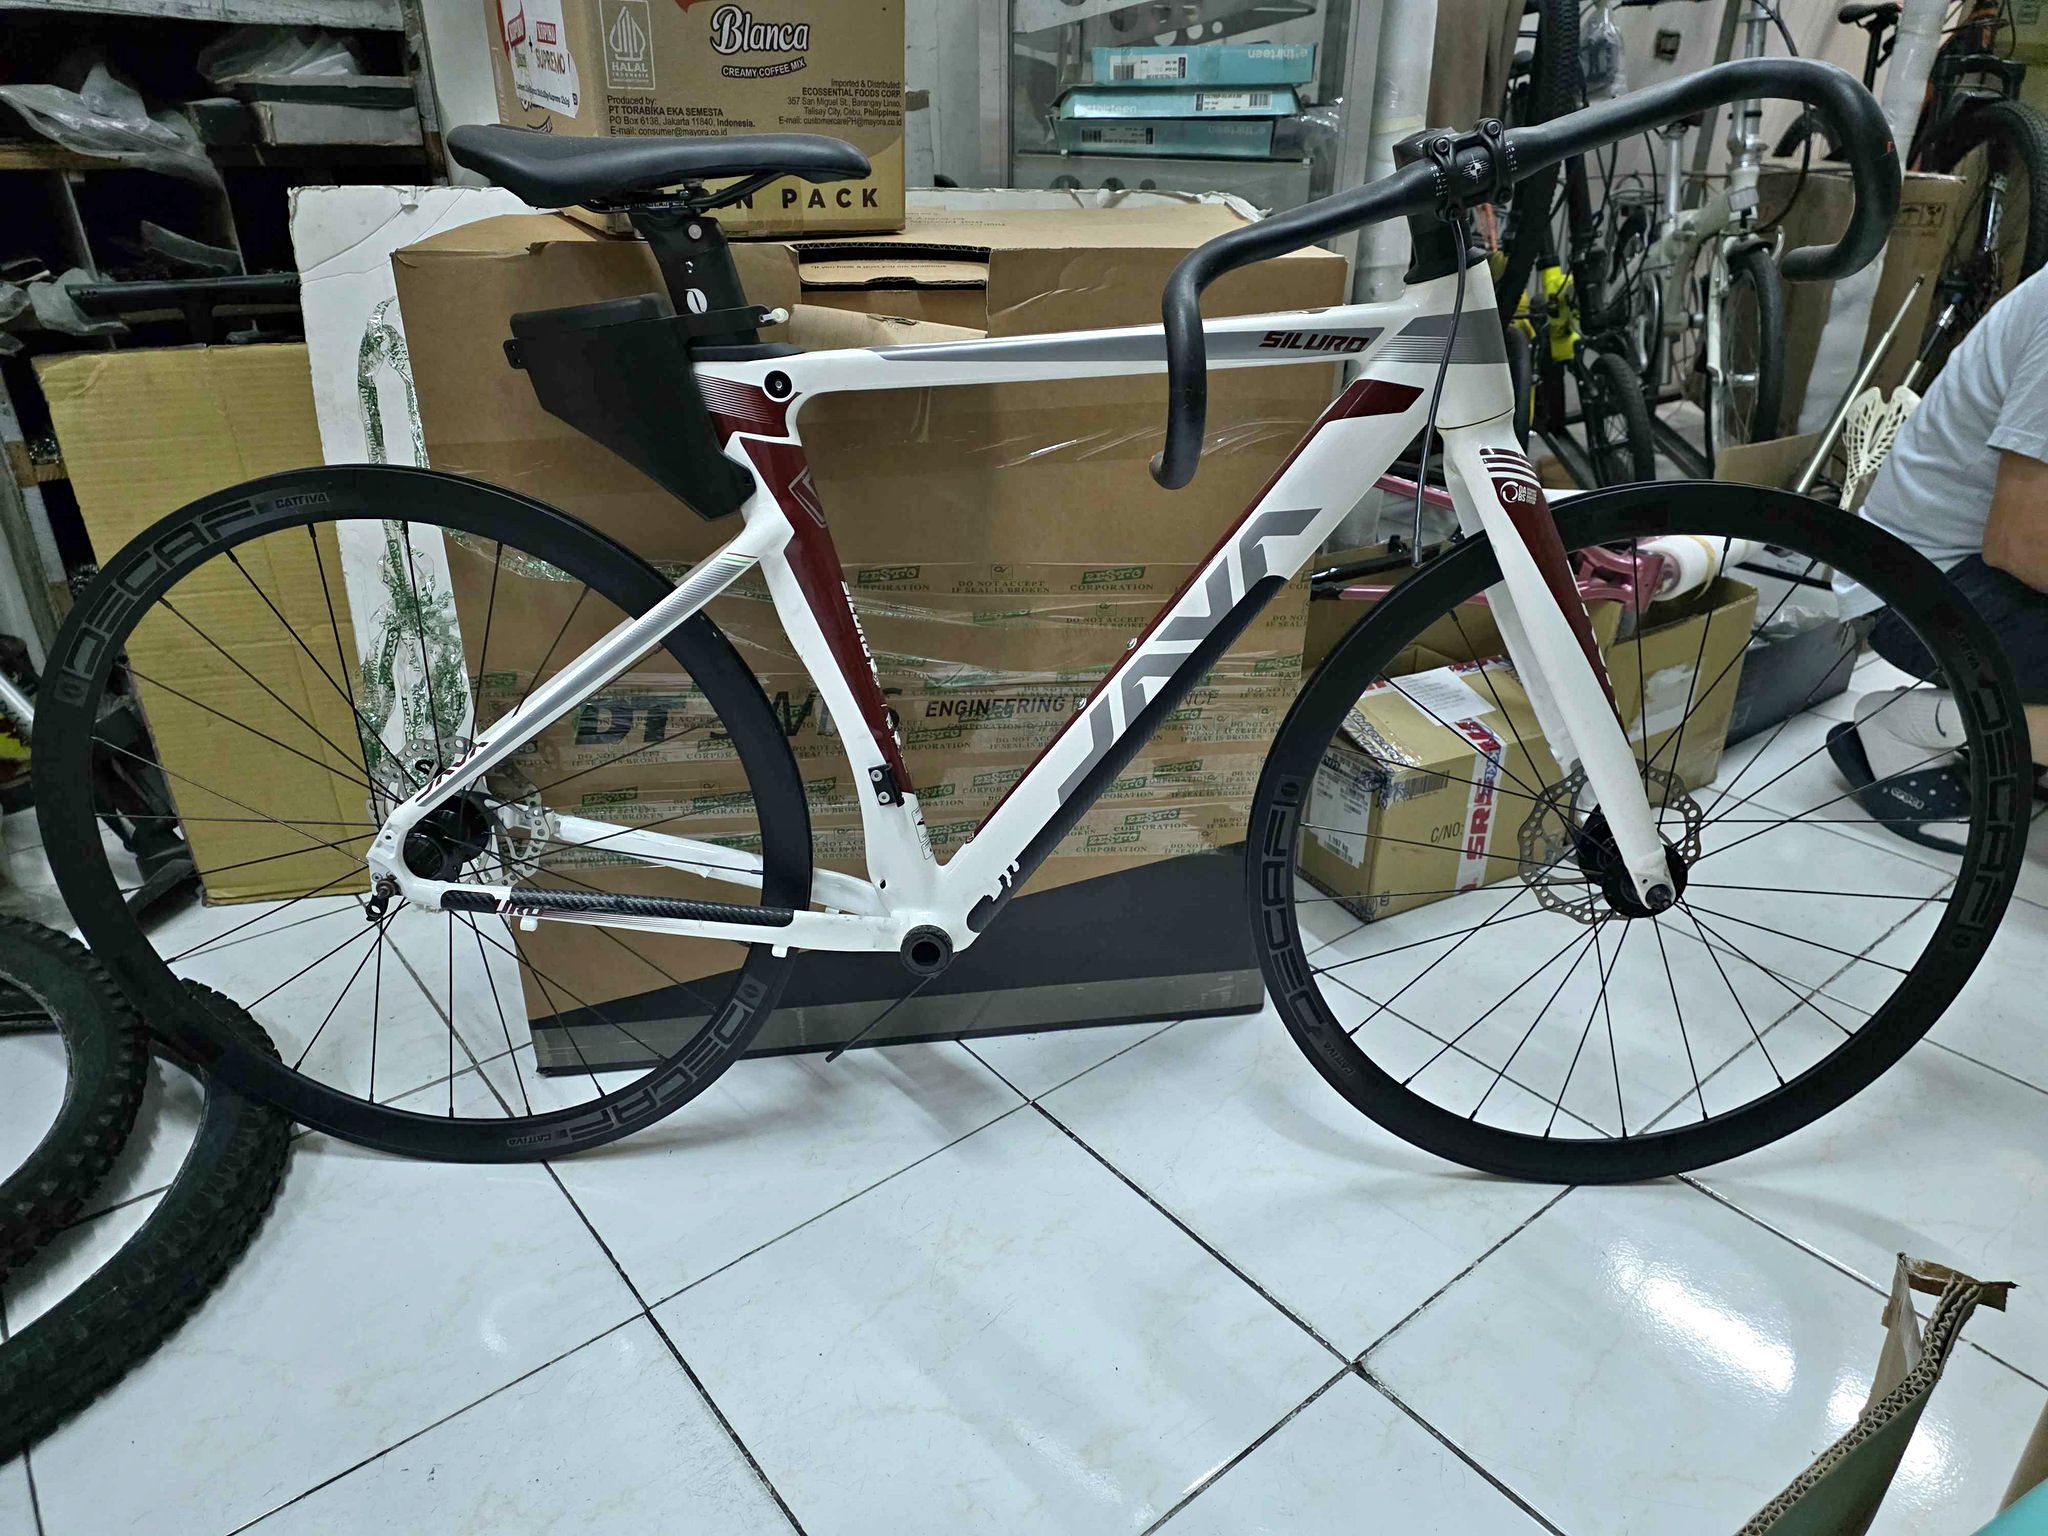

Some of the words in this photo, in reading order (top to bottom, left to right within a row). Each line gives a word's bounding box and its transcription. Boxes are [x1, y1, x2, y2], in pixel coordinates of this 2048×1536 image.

[710, 4, 810, 55] Blanca
[612, 62, 649, 73] HALAL
[723, 66, 758, 78] CREAMY
[759, 63, 791, 78] COFFEE
[791, 58, 806, 71] MIX
[802, 87, 853, 97] ECOSSENTIAL
[854, 88, 880, 98] FOODS
[607, 95, 644, 106] Produced
[801, 96, 815, 106] San
[816, 97, 838, 107] Miguel
[851, 97, 882, 108] Barangay
[608, 106, 620, 115] PT
[621, 106, 665, 116] TORABIKA
[666, 107, 684, 116] EKA
[685, 108, 724, 117] SEMESTA
[609, 116, 622, 125] PO
[623, 116, 638, 125] Box
[662, 117, 690, 126] Jakarta
[610, 126, 637, 136] E-mail:
[638, 126, 728, 137] consumer@mayora.co.id
[781, 187, 879, 210] PACK
[1258, 330, 1370, 353] SILURO
[274, 491, 331, 510] CATTIVA
[854, 584, 931, 592] ORPORATION
[1070, 583, 1154, 592] CORPORATION
[925, 697, 1066, 718] ENGINEERING
[902, 741, 971, 751] ORPORATION
[1113, 822, 1188, 832] CORPORATION
